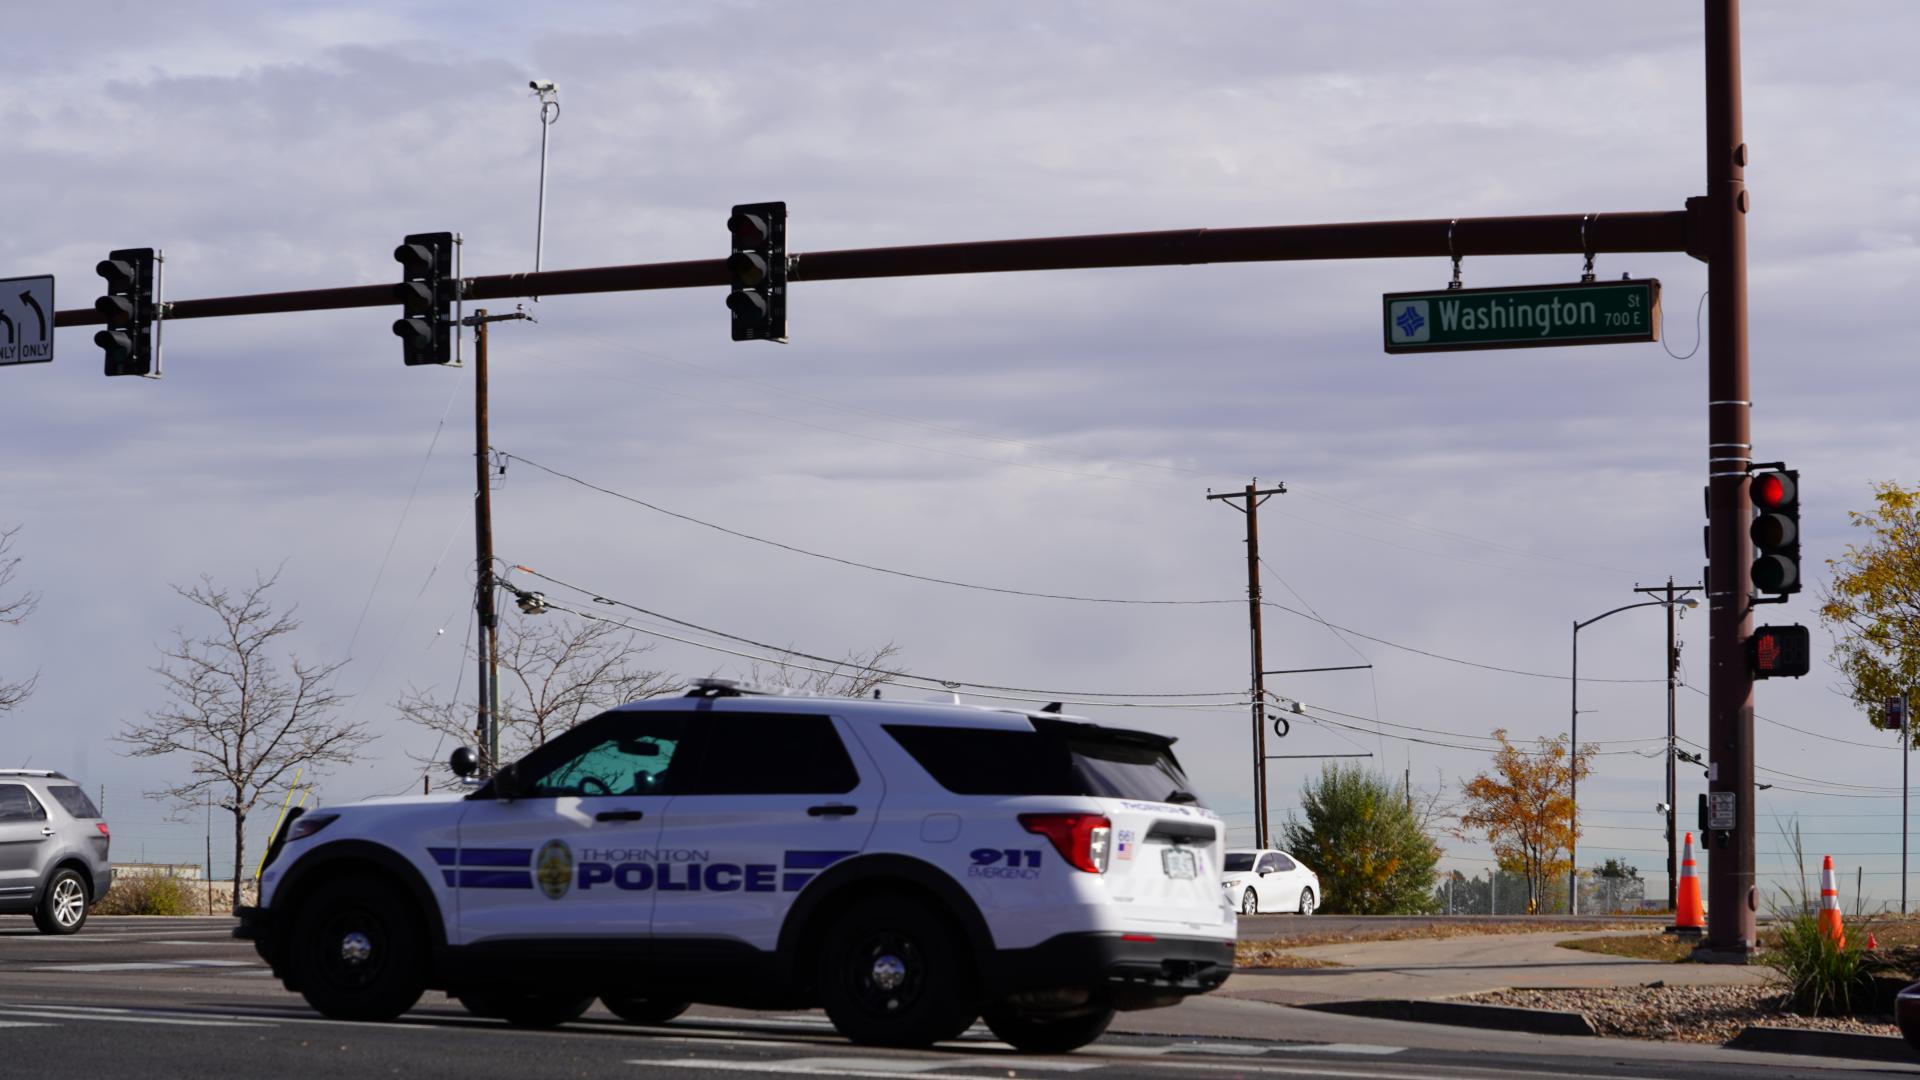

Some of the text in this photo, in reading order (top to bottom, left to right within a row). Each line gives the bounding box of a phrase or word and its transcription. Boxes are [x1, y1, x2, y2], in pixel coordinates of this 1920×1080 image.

[1627, 294, 1640, 308] St
[1439, 296, 1596, 336] Washington
[1604, 311, 1641, 327] 700 E
[0, 345, 16, 359] NLY
[22, 343, 49, 358] ONLY
[580, 848, 710, 862] THORNTON
[969, 848, 1042, 868] 911
[577, 862, 777, 892] POLICE
[967, 866, 1041, 880] EMERGENCY
